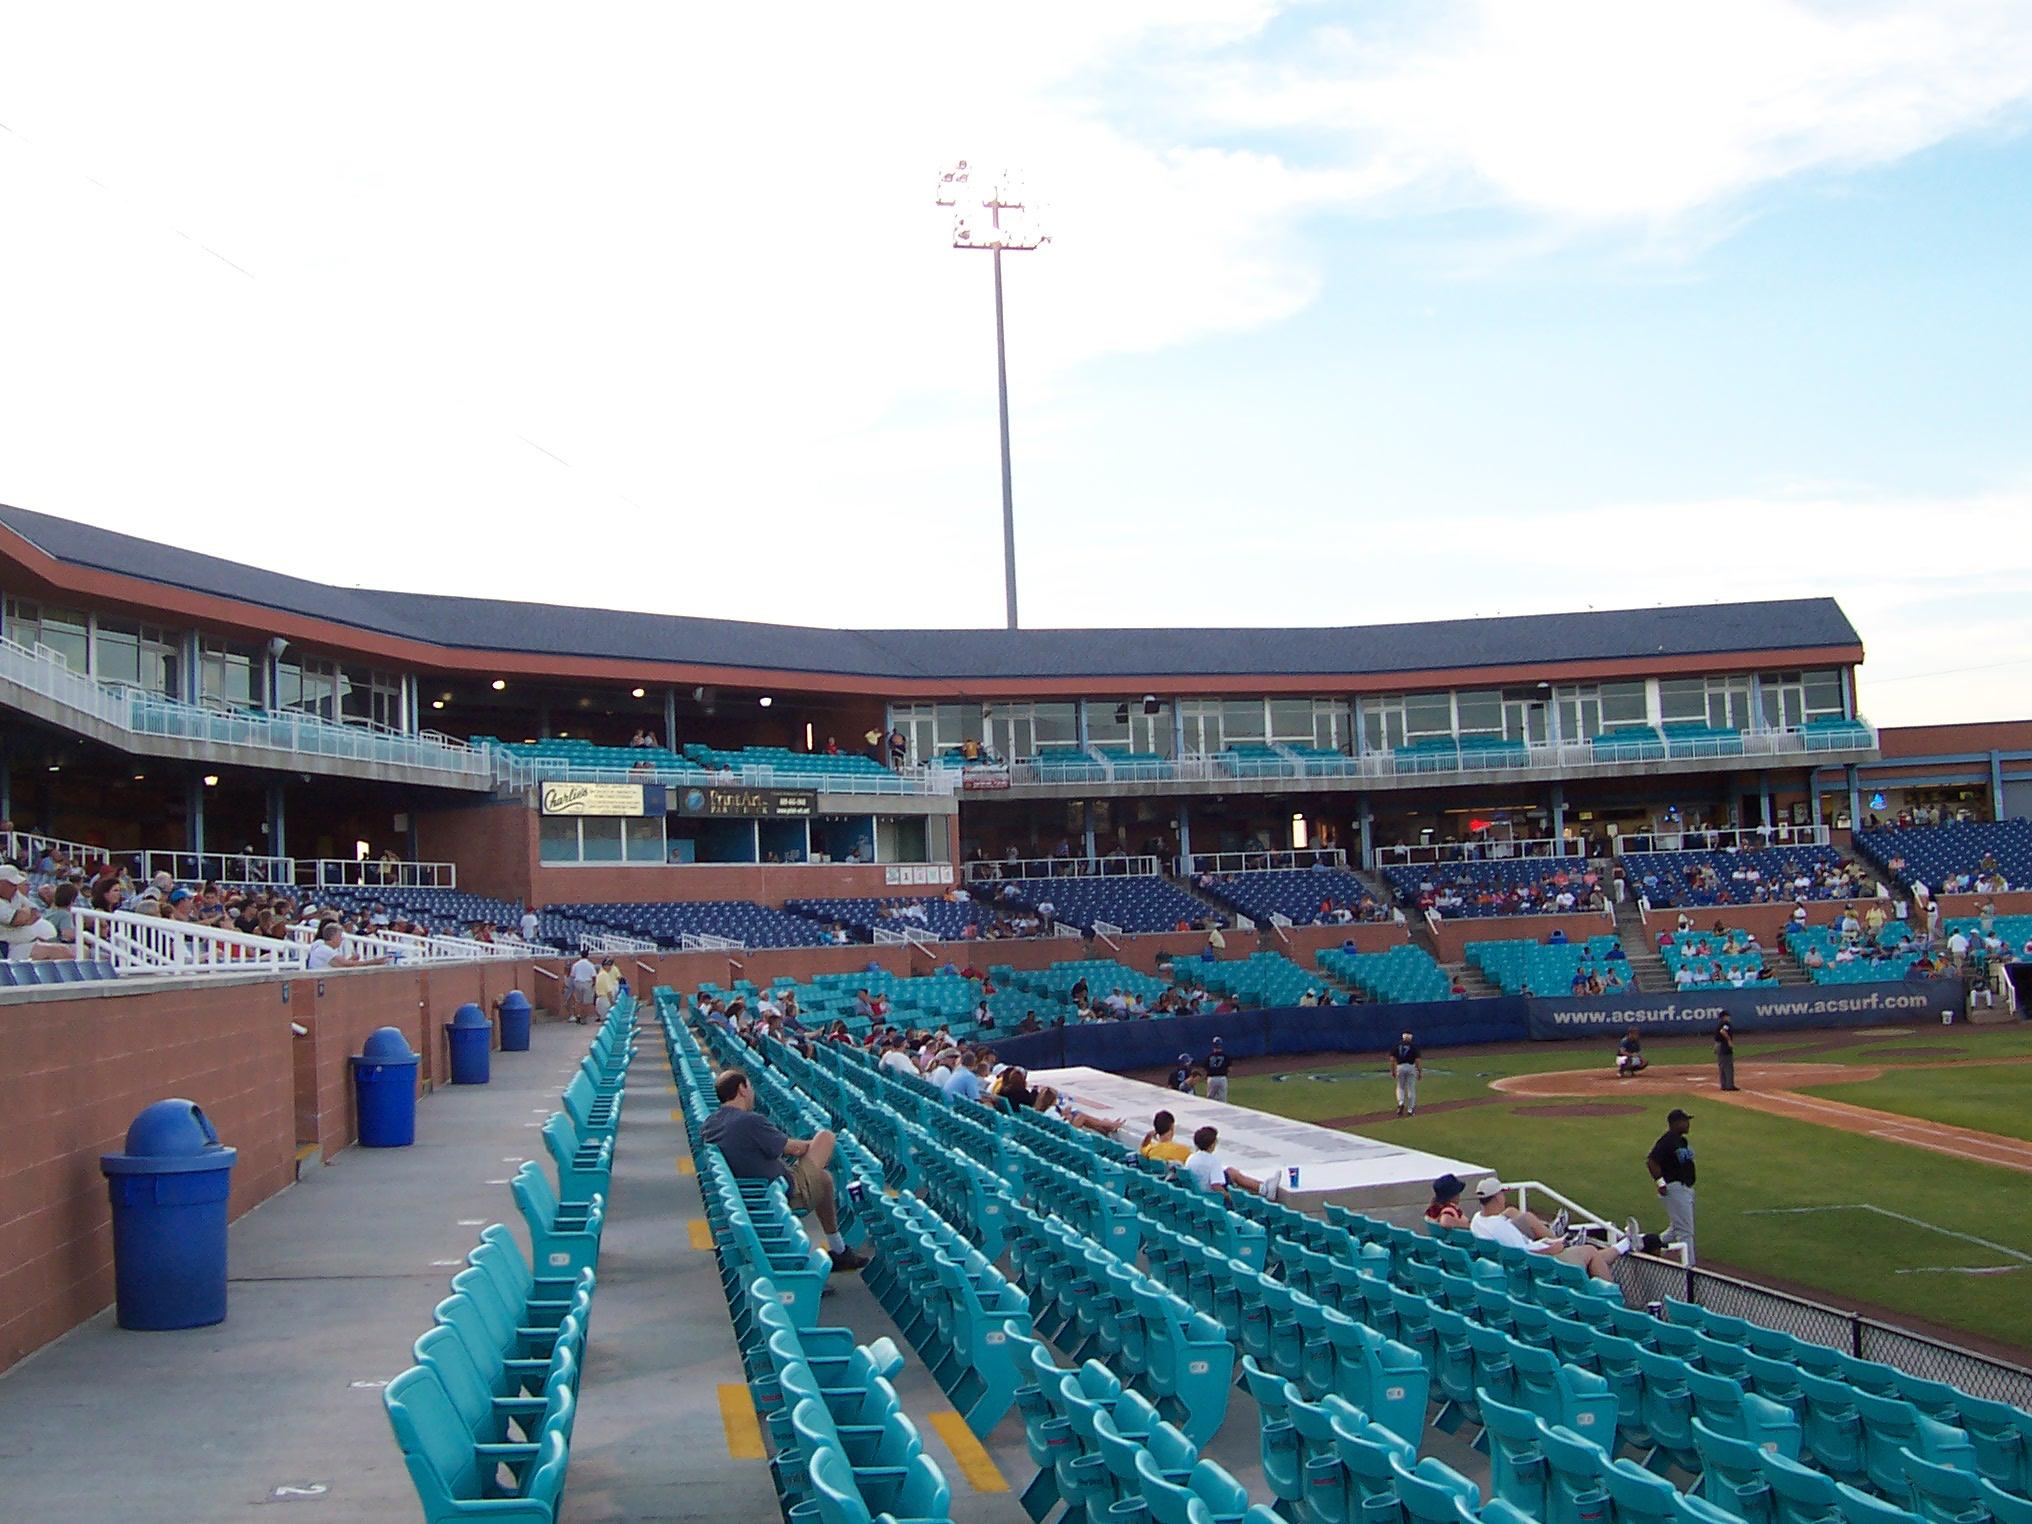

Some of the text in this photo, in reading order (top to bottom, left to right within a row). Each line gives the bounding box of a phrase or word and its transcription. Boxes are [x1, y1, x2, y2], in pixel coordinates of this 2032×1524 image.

[544, 788, 588, 812] Charlie's
[1553, 1005, 1724, 1024] www.acsurf.com
[1755, 992, 1928, 1017] www.acsurf.com
